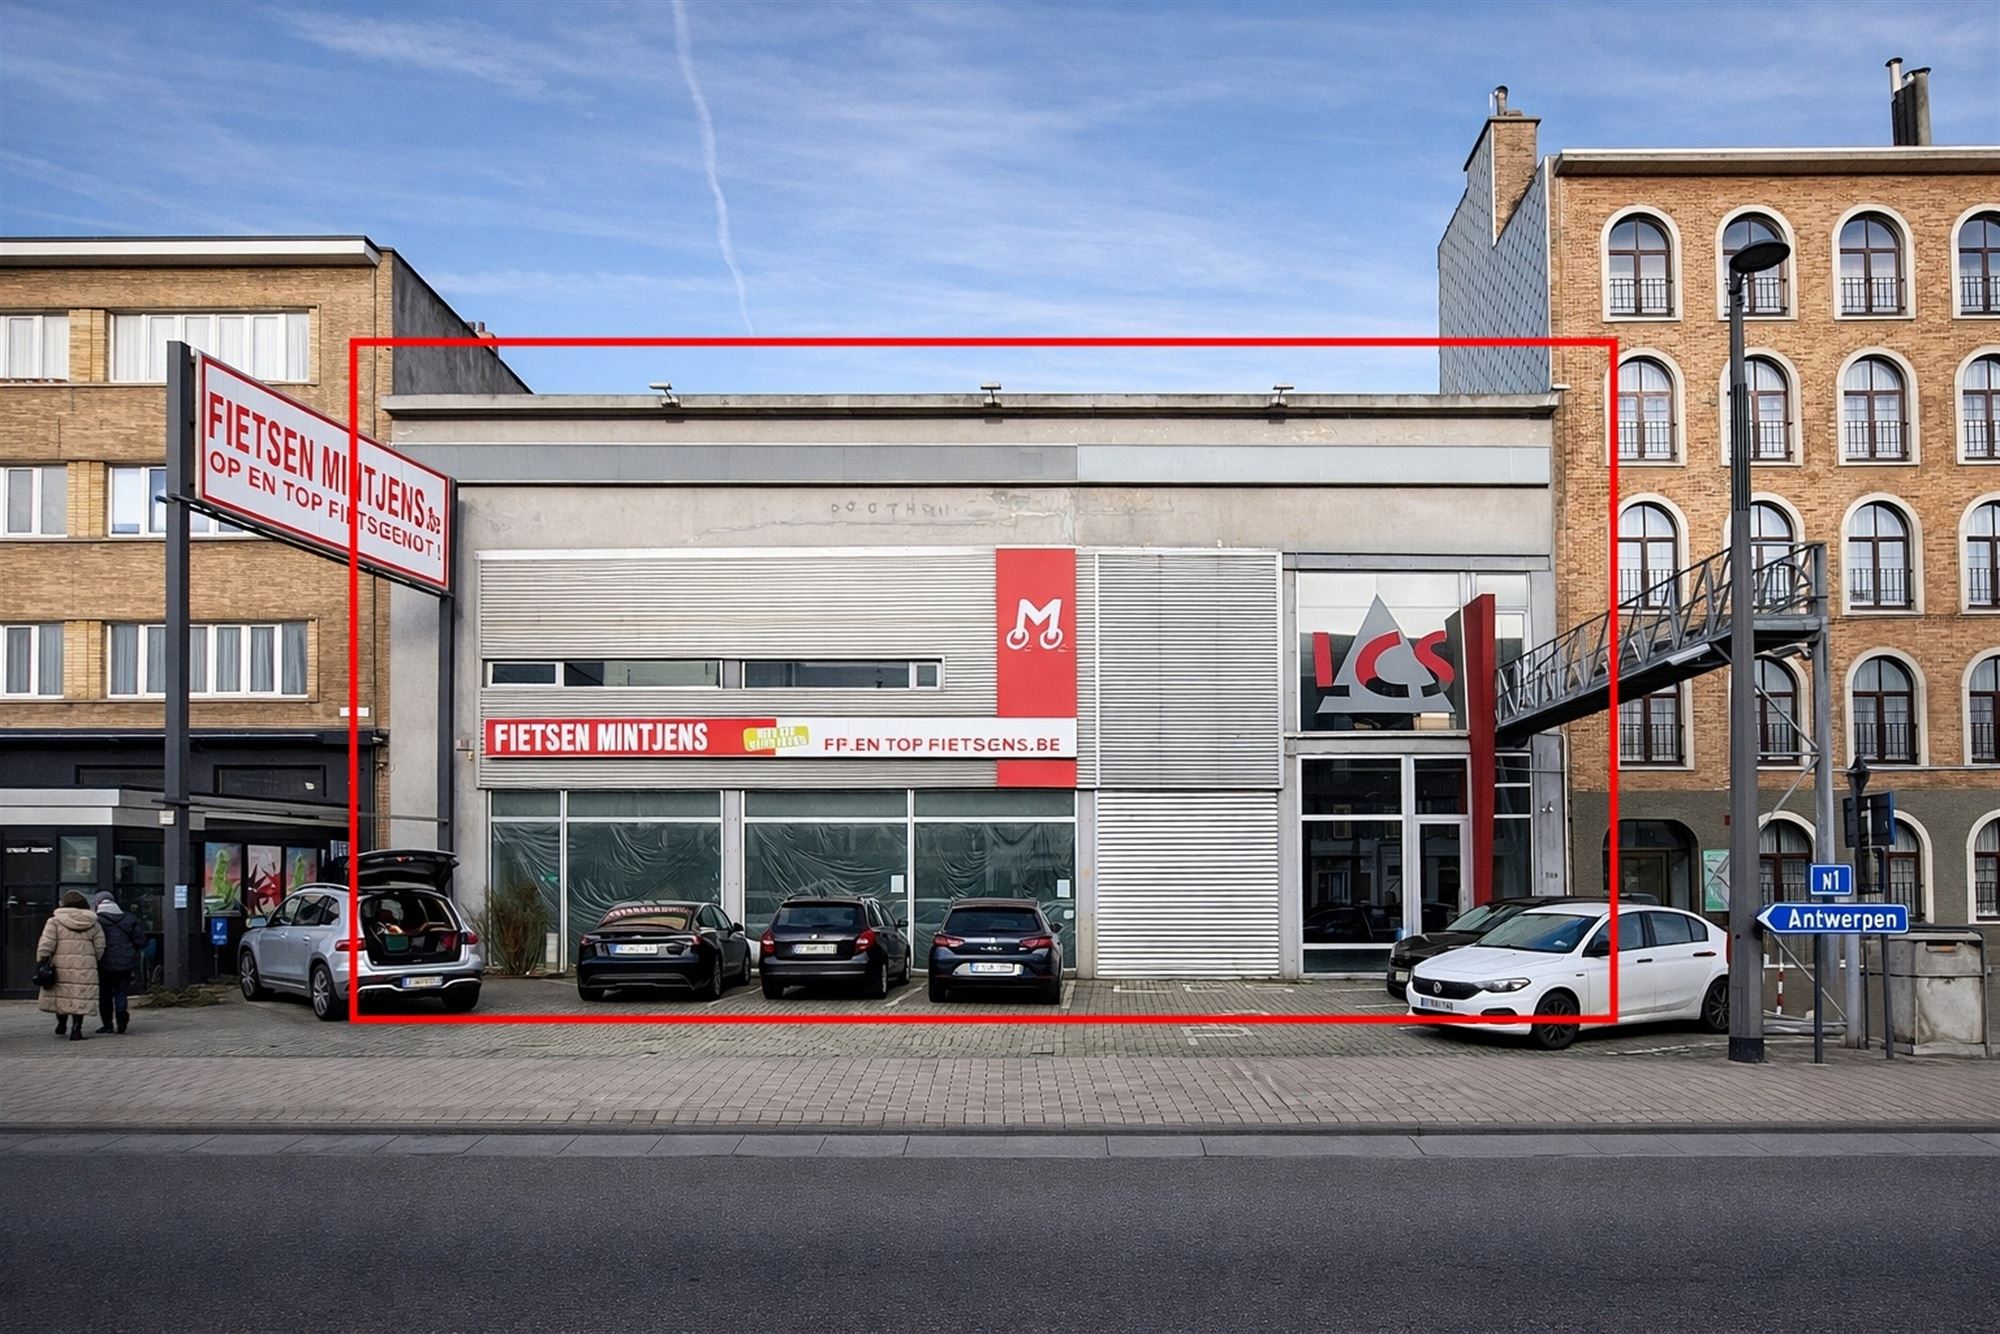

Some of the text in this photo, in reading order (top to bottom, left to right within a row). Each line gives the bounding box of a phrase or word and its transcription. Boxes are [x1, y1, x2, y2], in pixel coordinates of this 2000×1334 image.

[209, 391, 425, 528] FIETSEN MITJENS
[210, 451, 241, 478] OP
[249, 466, 275, 495] EN
[283, 480, 322, 511] TOP
[1016, 598, 1063, 641] M
[1312, 628, 1456, 698] LCS
[495, 723, 709, 752] FIETSEN MINTJENS
[885, 738, 923, 752] TOP
[1822, 869, 1840, 891] N1
[1788, 908, 1897, 933] Antwerpen
